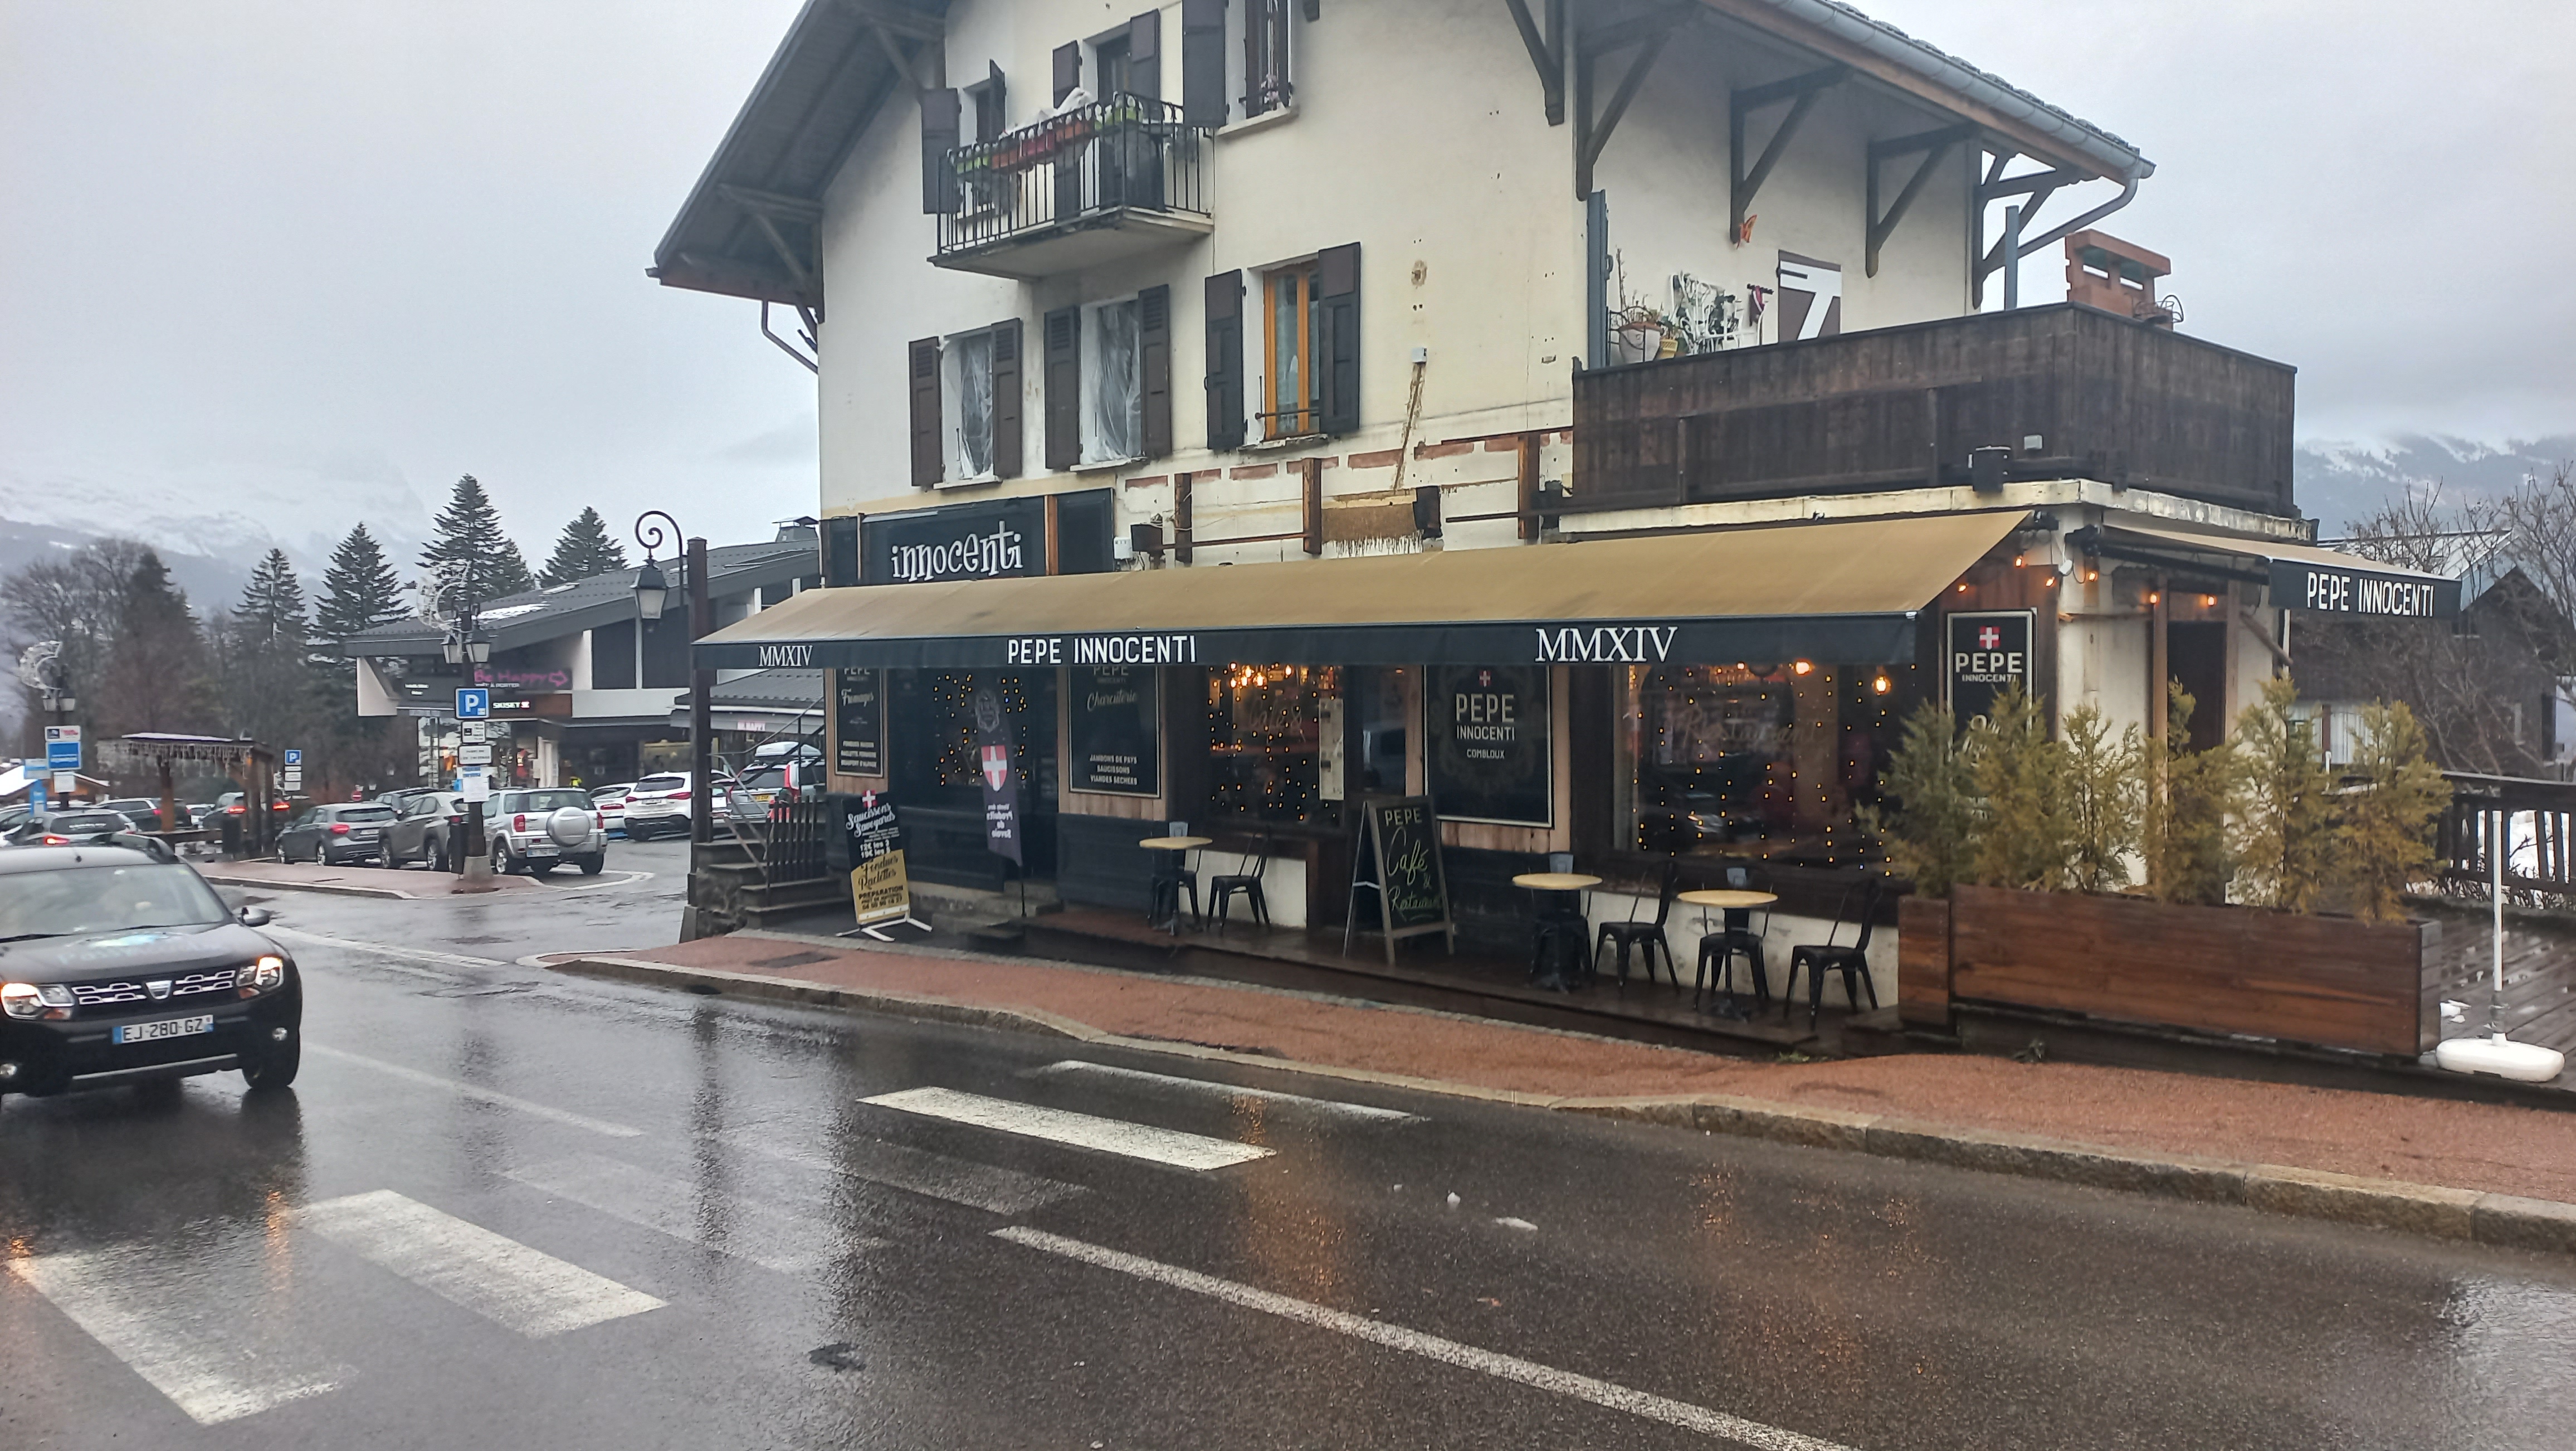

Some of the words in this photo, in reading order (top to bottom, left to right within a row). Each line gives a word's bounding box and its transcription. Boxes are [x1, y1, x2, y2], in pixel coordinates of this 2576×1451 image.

[891, 519, 1023, 582] innocenti
[2307, 572, 2350, 612] PEPE
[2358, 577, 2434, 617] INNOCENTI
[1007, 638, 1062, 665] PEPE
[1074, 635, 1197, 664] INNOCENTI
[1535, 626, 1678, 663] MMXIV
[758, 645, 813, 667] MMXIV
[1955, 653, 2023, 673] PEPE
[1094, 666, 1129, 676] PEPE
[1962, 674, 2017, 683] INNOCENTI
[465, 694, 480, 713] P
[1087, 688, 1139, 712] Charcuterie
[1456, 693, 1515, 723] PEPE
[1456, 725, 1515, 741] INNOCENTI
[1124, 756, 1138, 765] PAYS
[1466, 748, 1505, 759] COMBLOUX
[1096, 765, 1130, 774] SAUCISSONS
[1385, 808, 1422, 826] PEPE
[1387, 826, 1429, 886] Café
